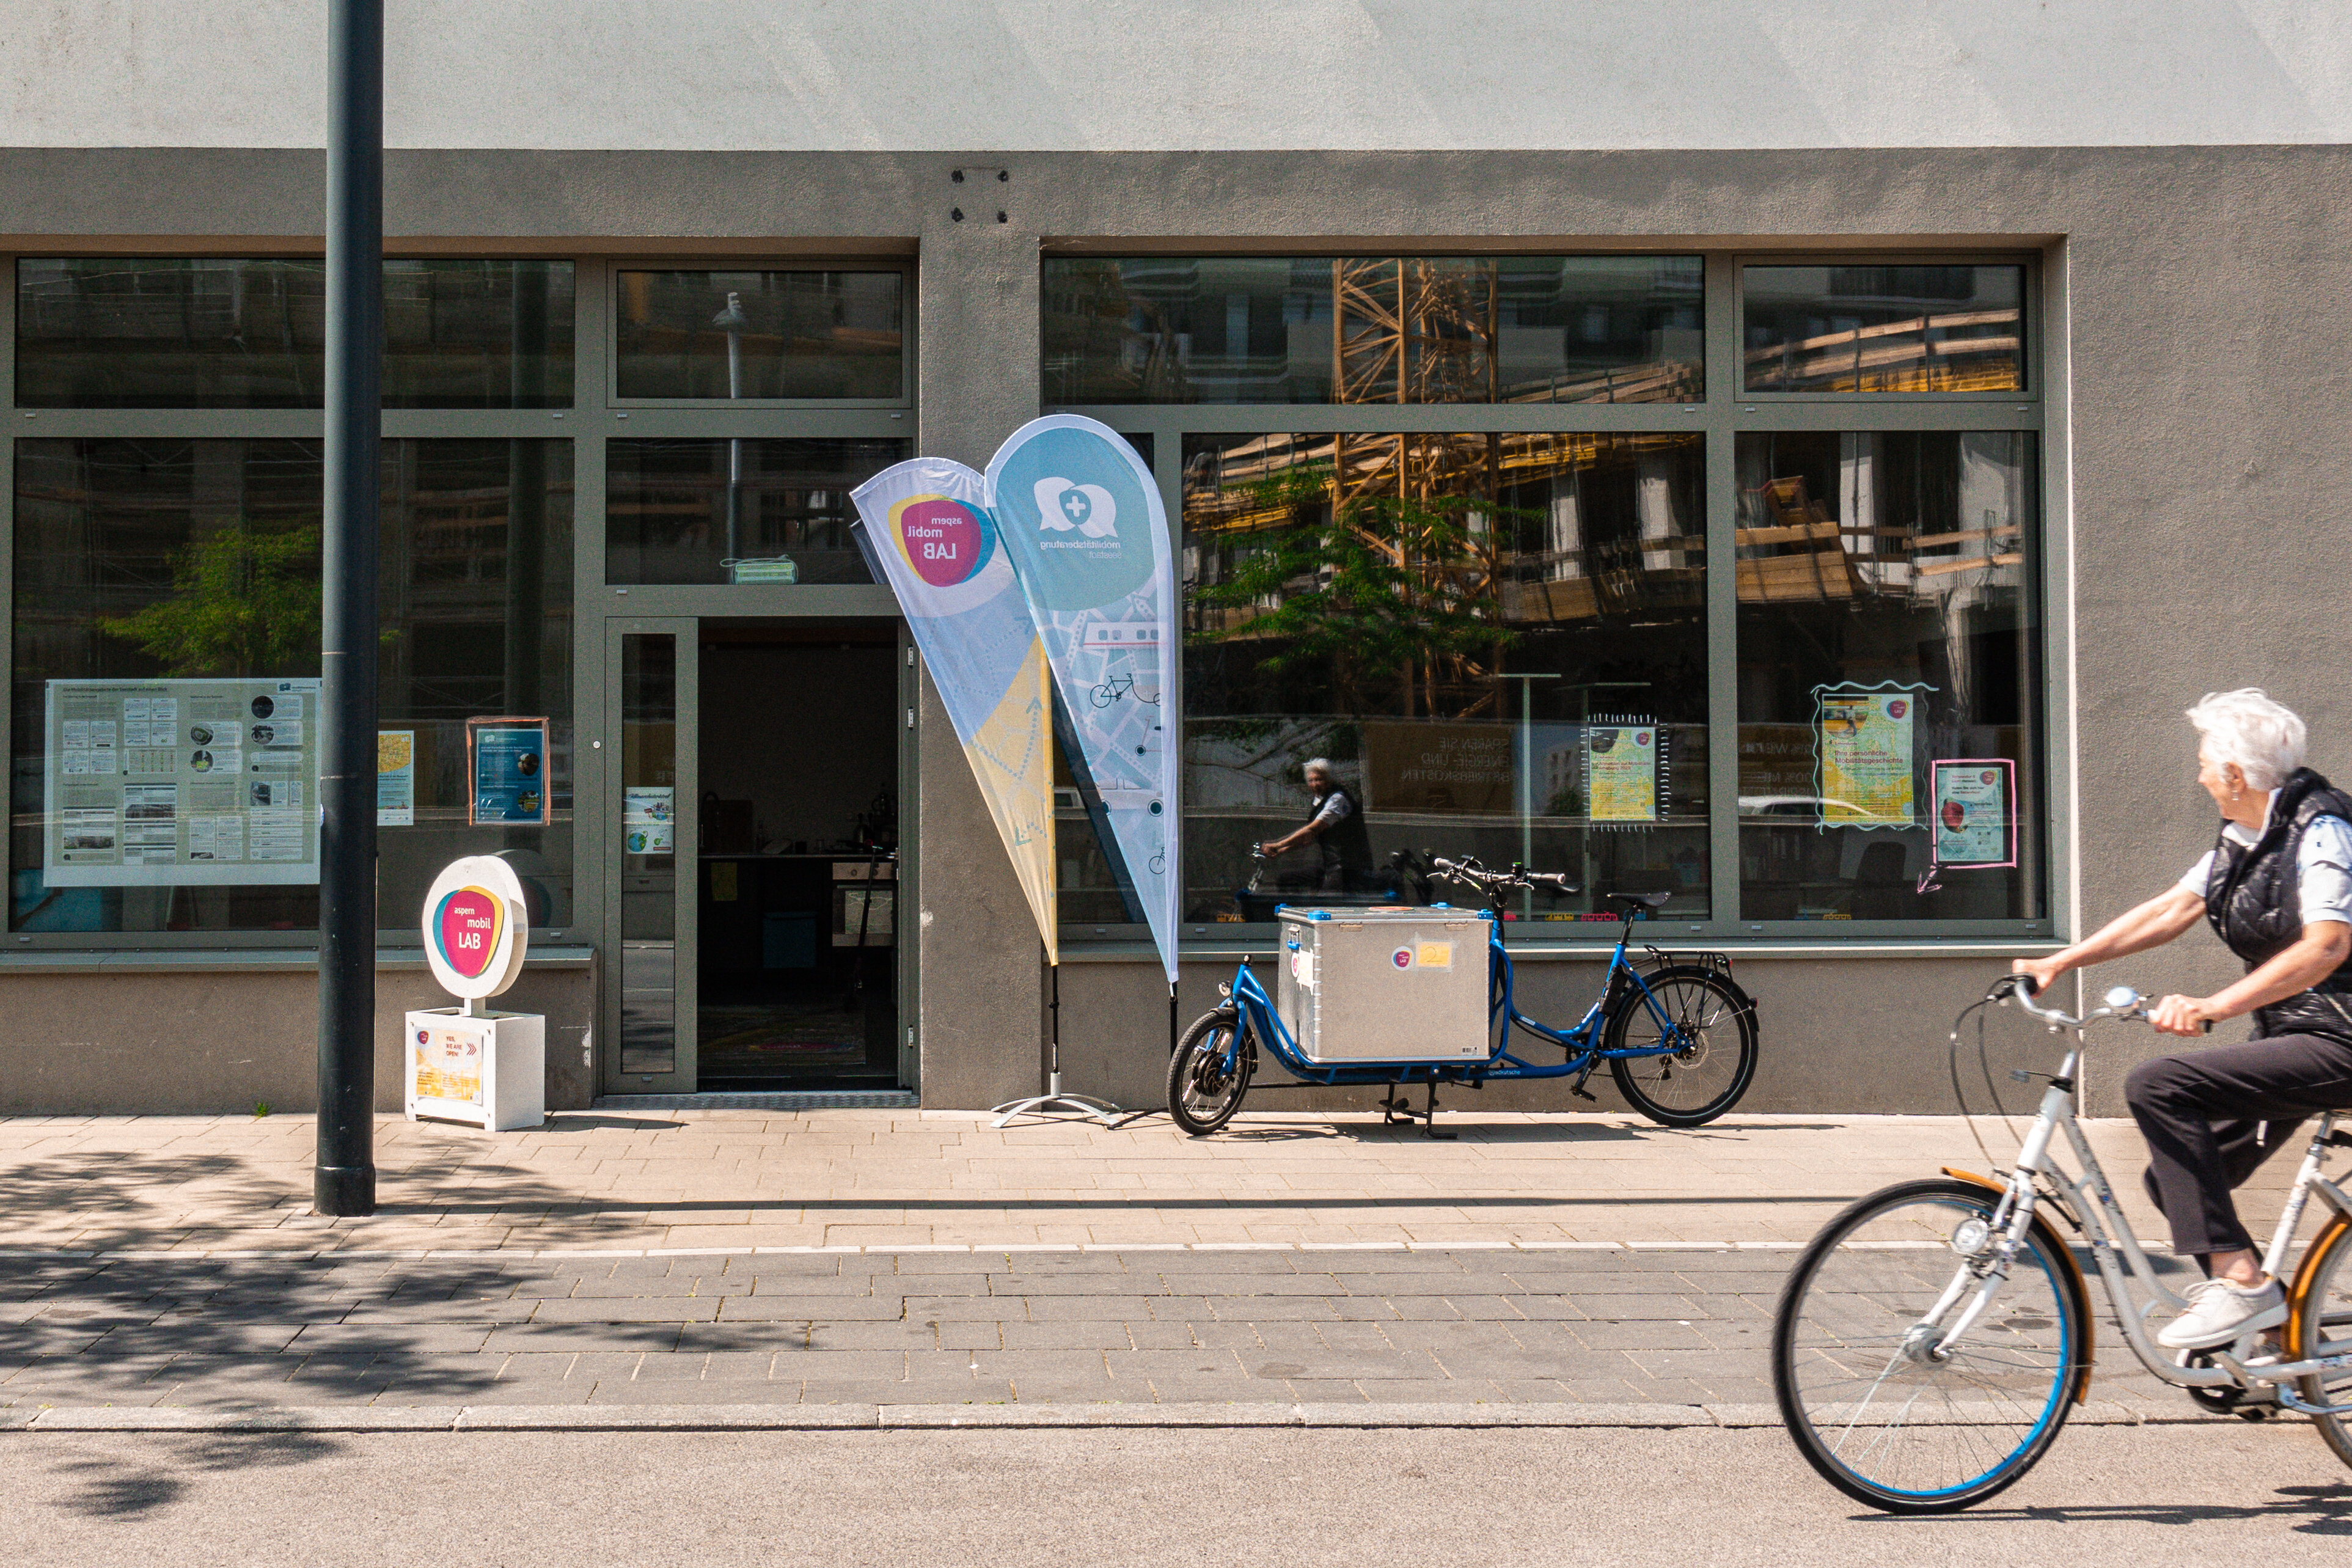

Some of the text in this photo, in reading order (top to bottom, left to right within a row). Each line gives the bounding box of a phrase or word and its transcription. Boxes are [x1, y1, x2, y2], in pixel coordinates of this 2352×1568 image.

[454, 907, 475, 916] aspern
[467, 917, 491, 929] mobil
[458, 932, 481, 950] LAB
[1425, 947, 1443, 962] 2
